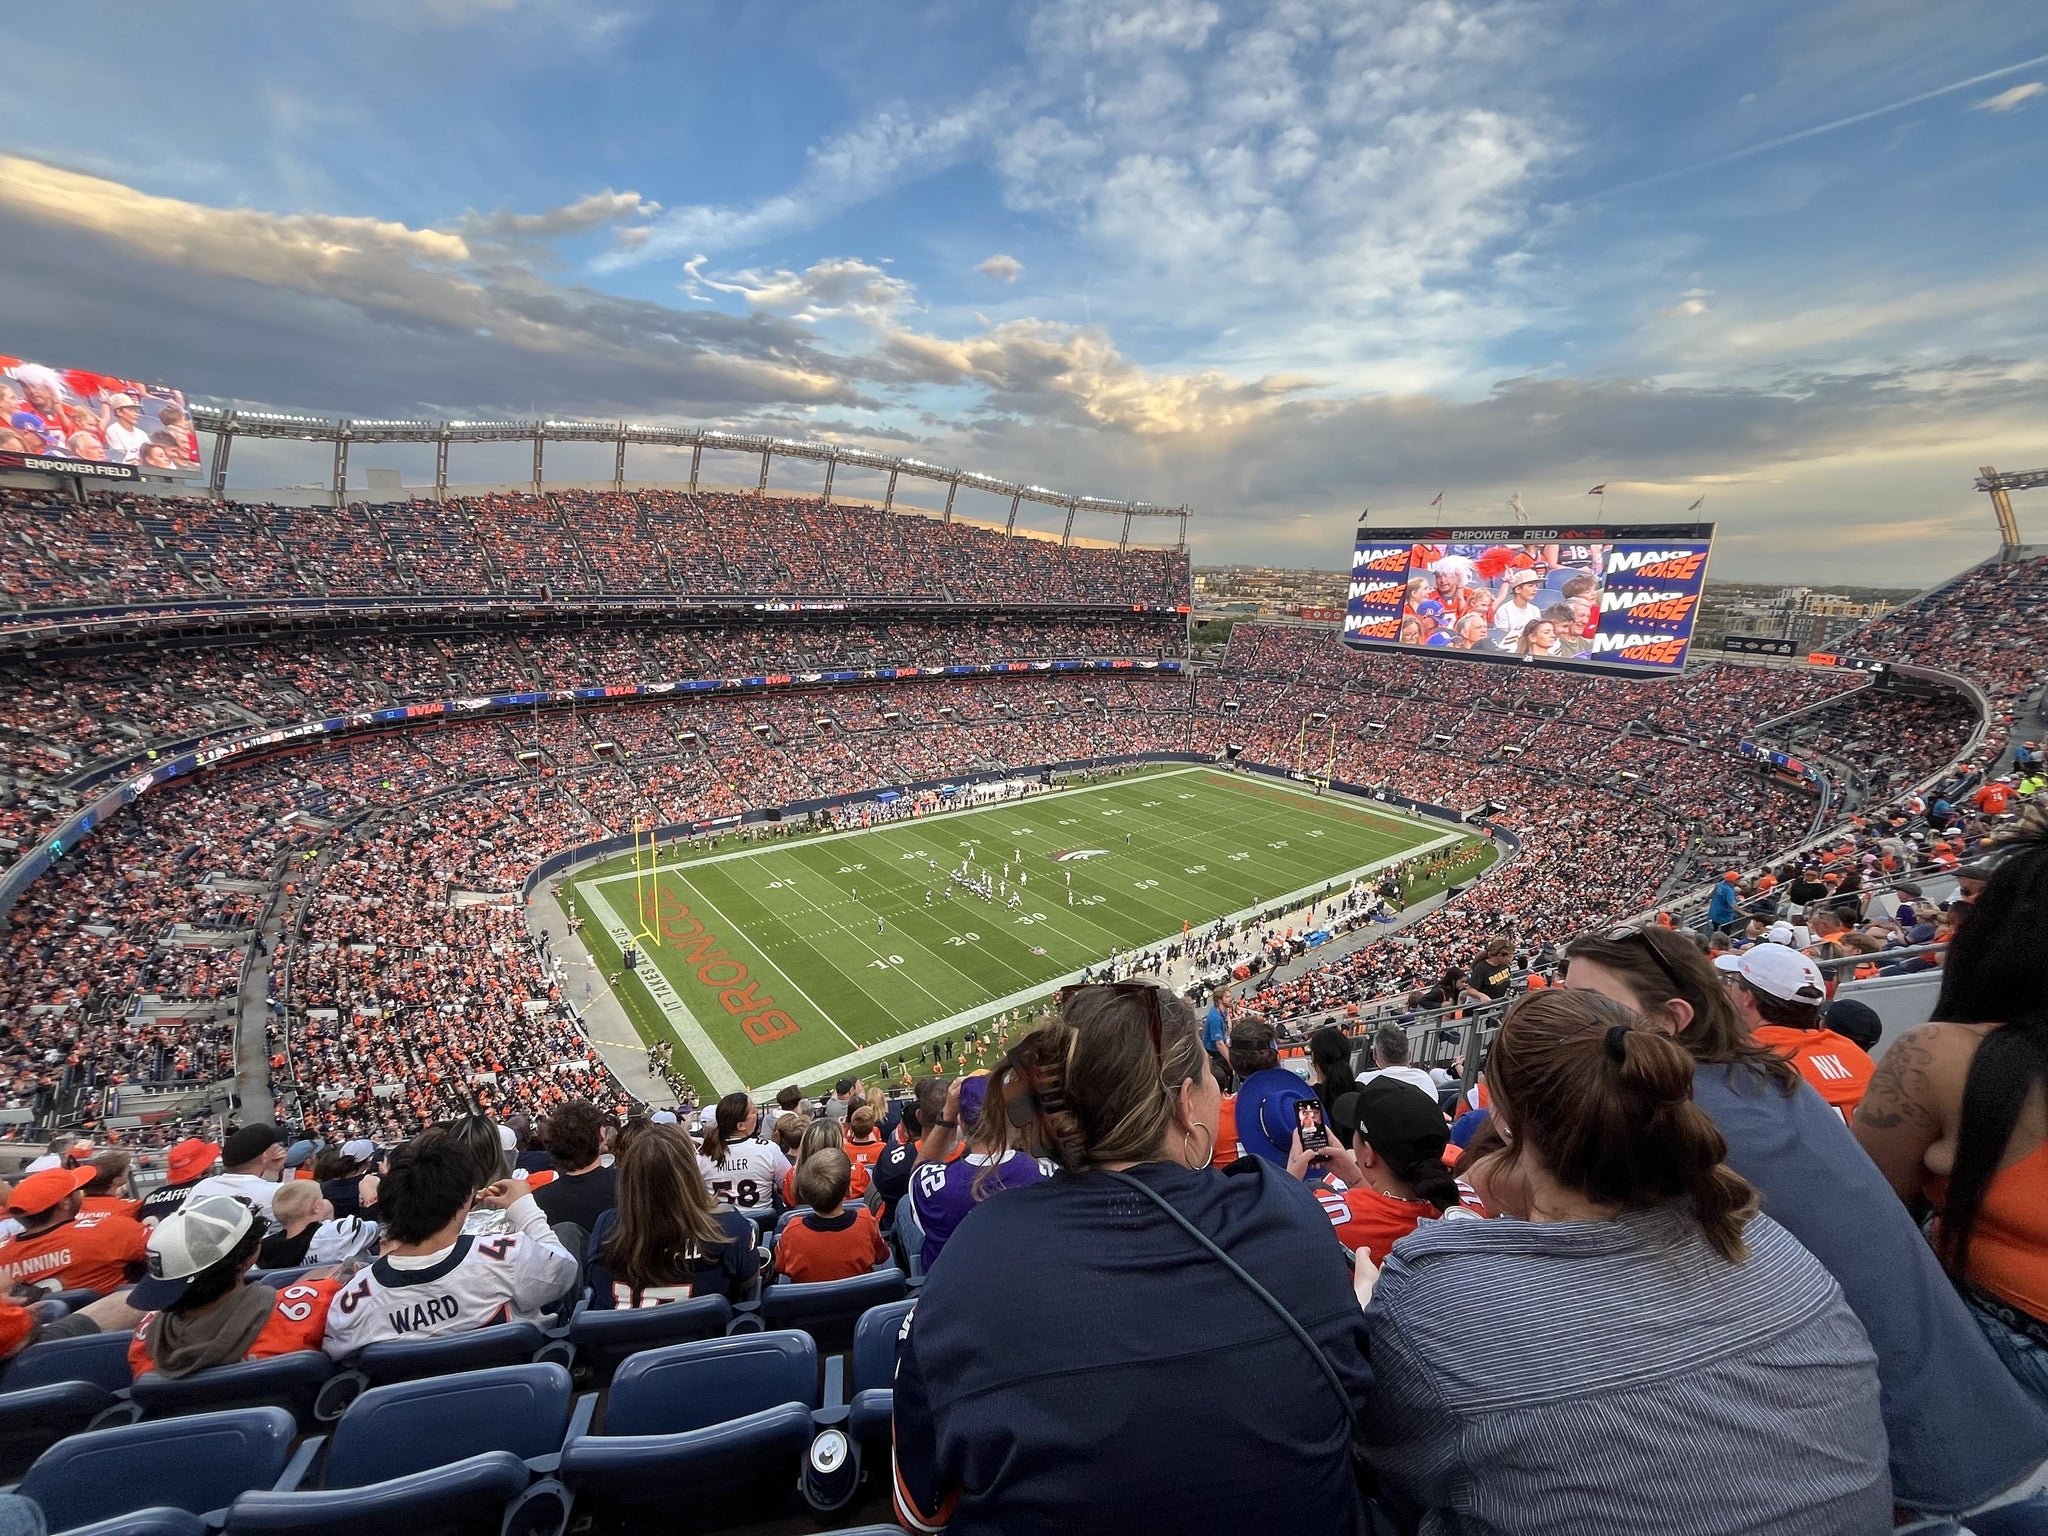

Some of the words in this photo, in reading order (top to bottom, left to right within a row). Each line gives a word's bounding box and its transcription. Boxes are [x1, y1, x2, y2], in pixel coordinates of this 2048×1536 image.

[24, 458, 95, 476] EMPOWER
[97, 465, 132, 479] FIELD
[1451, 530, 1510, 541] EMPOWER
[1523, 530, 1559, 541] FIELD
[1353, 549, 1403, 569] MAKE
[1366, 551, 1412, 572] NOISE
[1568, 545, 1590, 560] 18
[1606, 551, 1693, 574] MAKE
[1635, 553, 1708, 580] NOISE
[1348, 582, 1398, 600] MAKE
[1363, 584, 1408, 605] NOISE
[1600, 592, 1683, 613] MAKE
[1627, 594, 1698, 621] NOISE
[1344, 615, 1393, 632] MAKE
[1358, 619, 1402, 639] NOISE
[1592, 633, 1674, 653] MAKE
[1619, 638, 1689, 664] NOISE
[769, 878, 797, 889] 10
[1133, 879, 1160, 890] 50
[1080, 894, 1107, 907] 40
[1017, 911, 1048, 925] 30
[612, 927, 628, 939] US
[948, 932, 981, 947] 20
[632, 887, 802, 1046] BRONCOS
[872, 954, 905, 970] 10
[641, 968, 672, 999] TAKES
[662, 1000, 682, 1012] IT
[1809, 1054, 1853, 1080] NIX
[717, 1158, 749, 1173] MILLER
[920, 1163, 947, 1199] 22
[144, 1187, 192, 1206] McCAFFR
[712, 1178, 760, 1208] 58
[478, 1237, 517, 1262] 4
[0, 1249, 72, 1279] MANNING
[278, 1285, 318, 1322] 69
[389, 1294, 459, 1334] WARD
